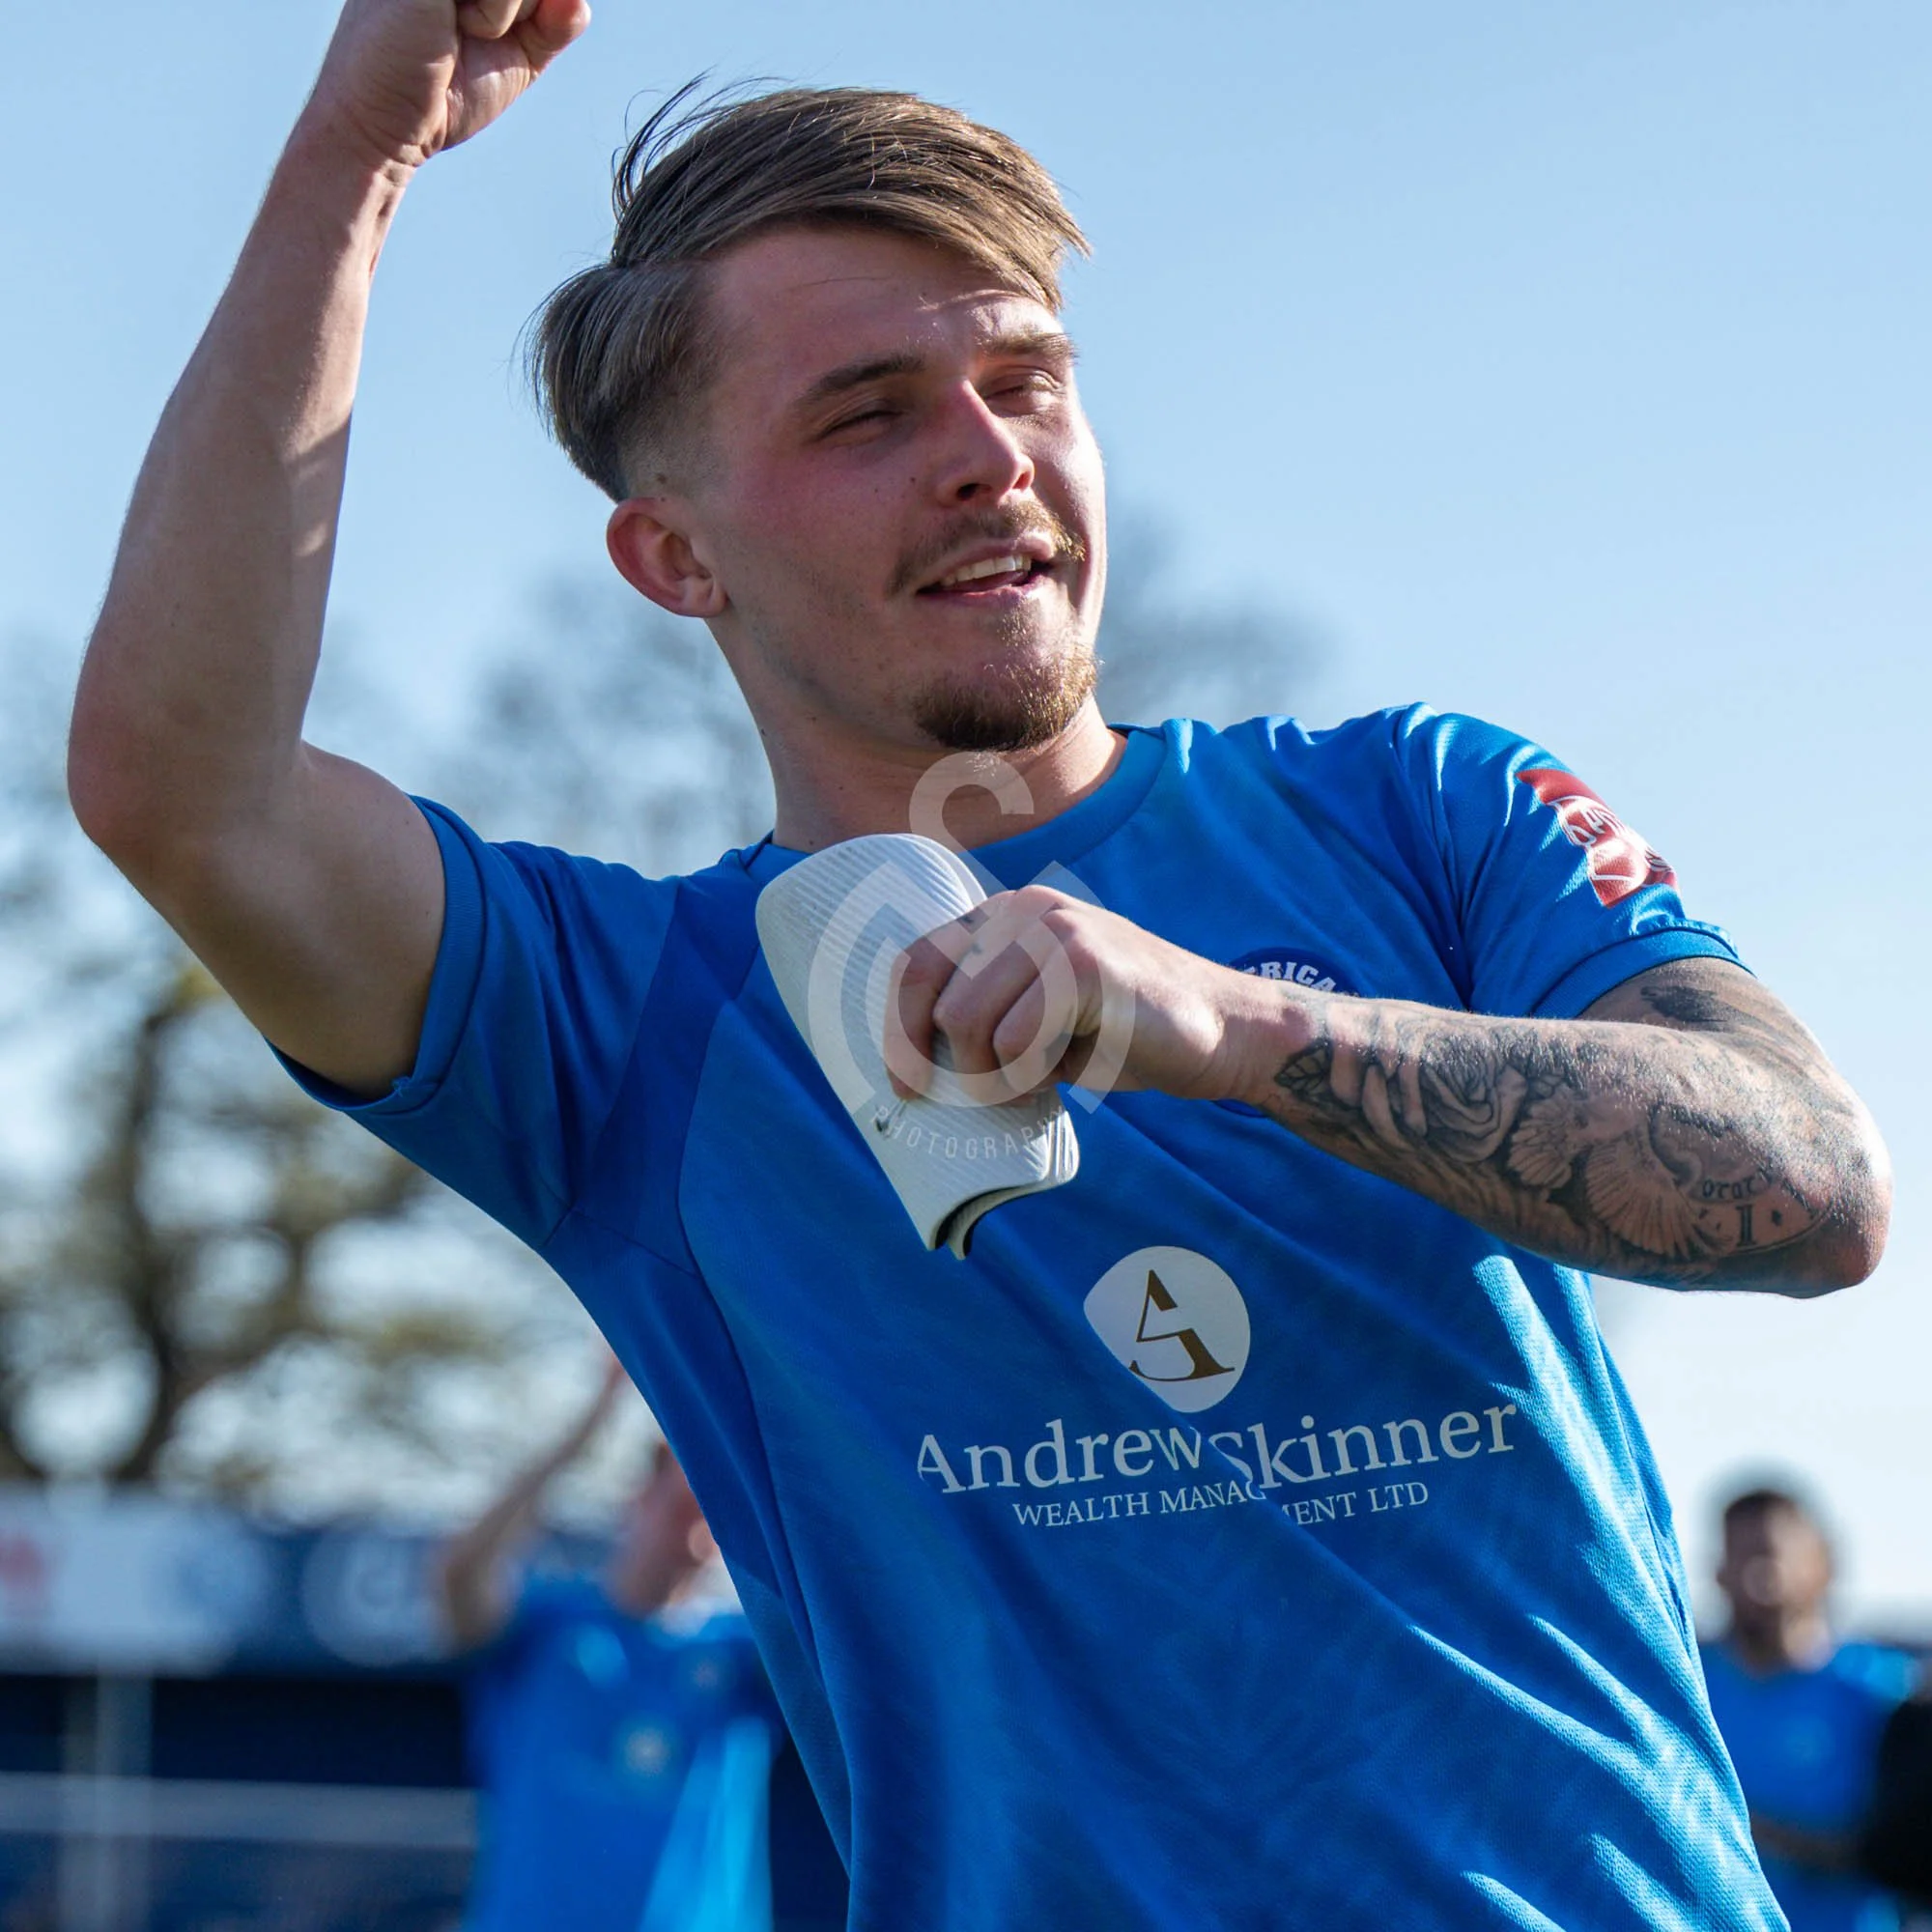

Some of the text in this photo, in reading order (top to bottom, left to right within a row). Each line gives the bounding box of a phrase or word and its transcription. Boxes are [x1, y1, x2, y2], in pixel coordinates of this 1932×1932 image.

[1243, 961, 1336, 992] RICA
[917, 1404, 1517, 1493] Andrew Skinner
[1012, 1492, 1151, 1526] WEALTH
[1368, 1482, 1429, 1513] LTD
